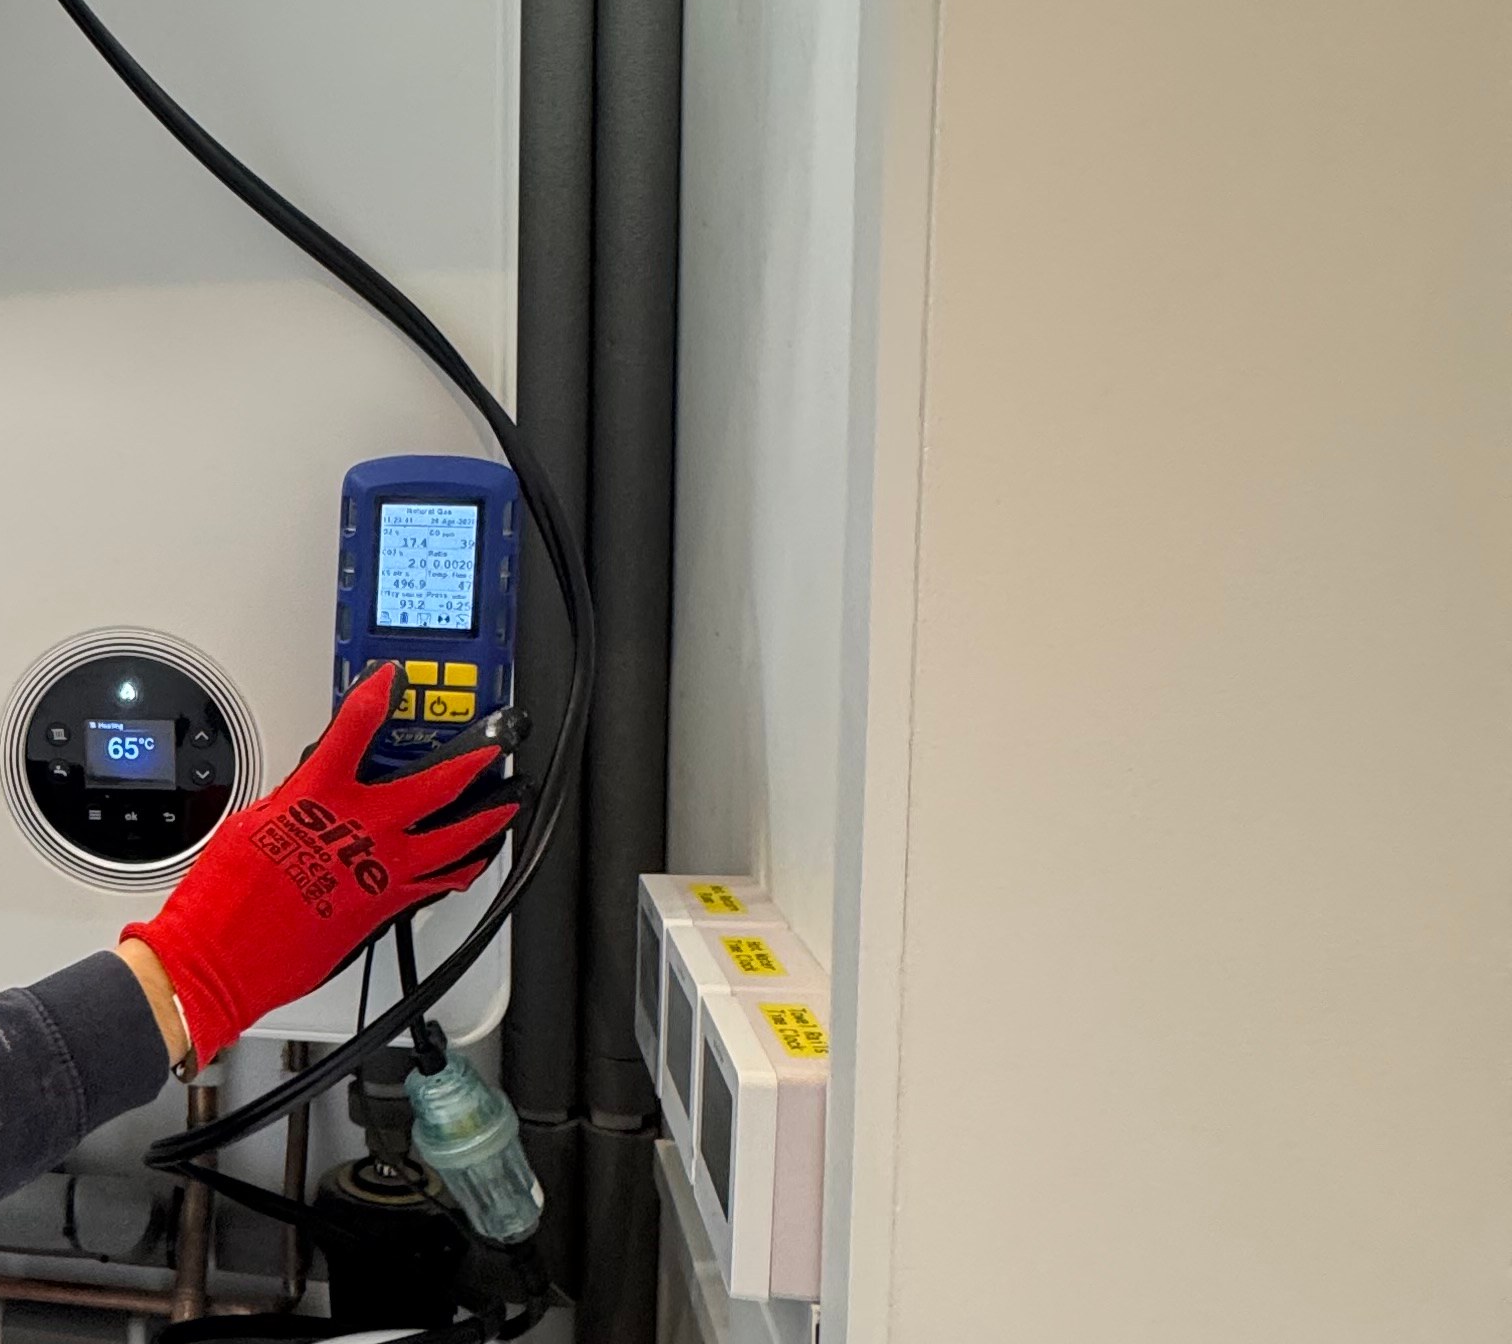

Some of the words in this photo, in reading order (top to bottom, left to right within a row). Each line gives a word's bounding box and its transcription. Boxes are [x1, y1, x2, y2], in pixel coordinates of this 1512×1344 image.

[402, 537, 428, 549] 17.4
[399, 599, 425, 610] 93.2
[108, 736, 155, 760] 65°C
[124, 811, 138, 821] ok
